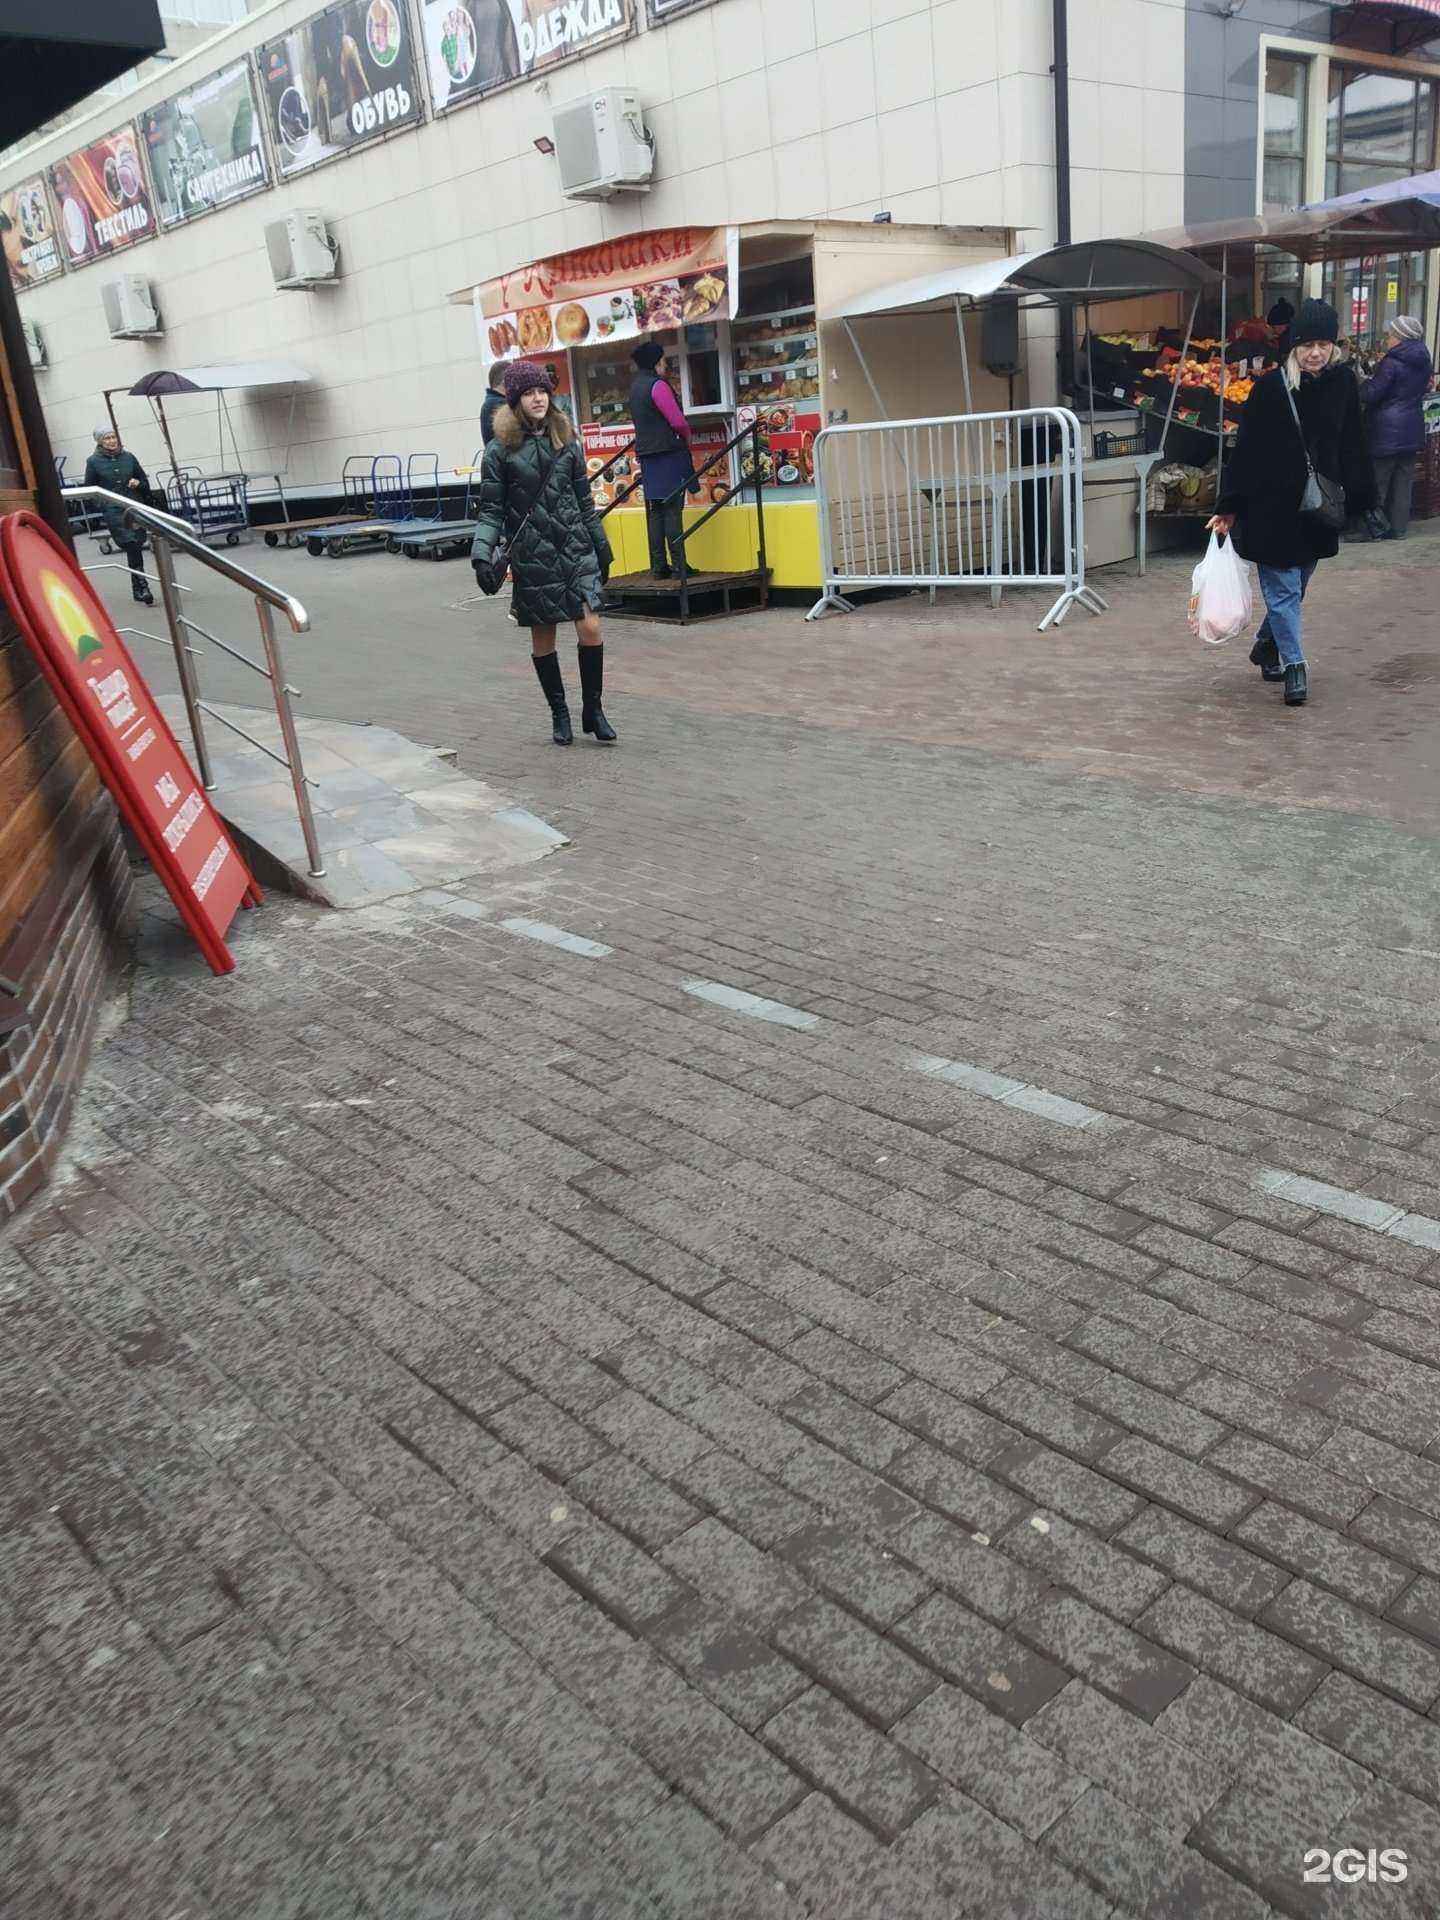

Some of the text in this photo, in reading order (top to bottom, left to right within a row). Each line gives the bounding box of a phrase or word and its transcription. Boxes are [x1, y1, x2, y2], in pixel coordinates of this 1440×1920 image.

[518, 0, 622, 61] ОДЕЖДА
[352, 83, 411, 134] ОБУВЬ
[187, 150, 262, 203] САНТЕХНИКА
[94, 203, 147, 245] ТЕКСТИЛЬ
